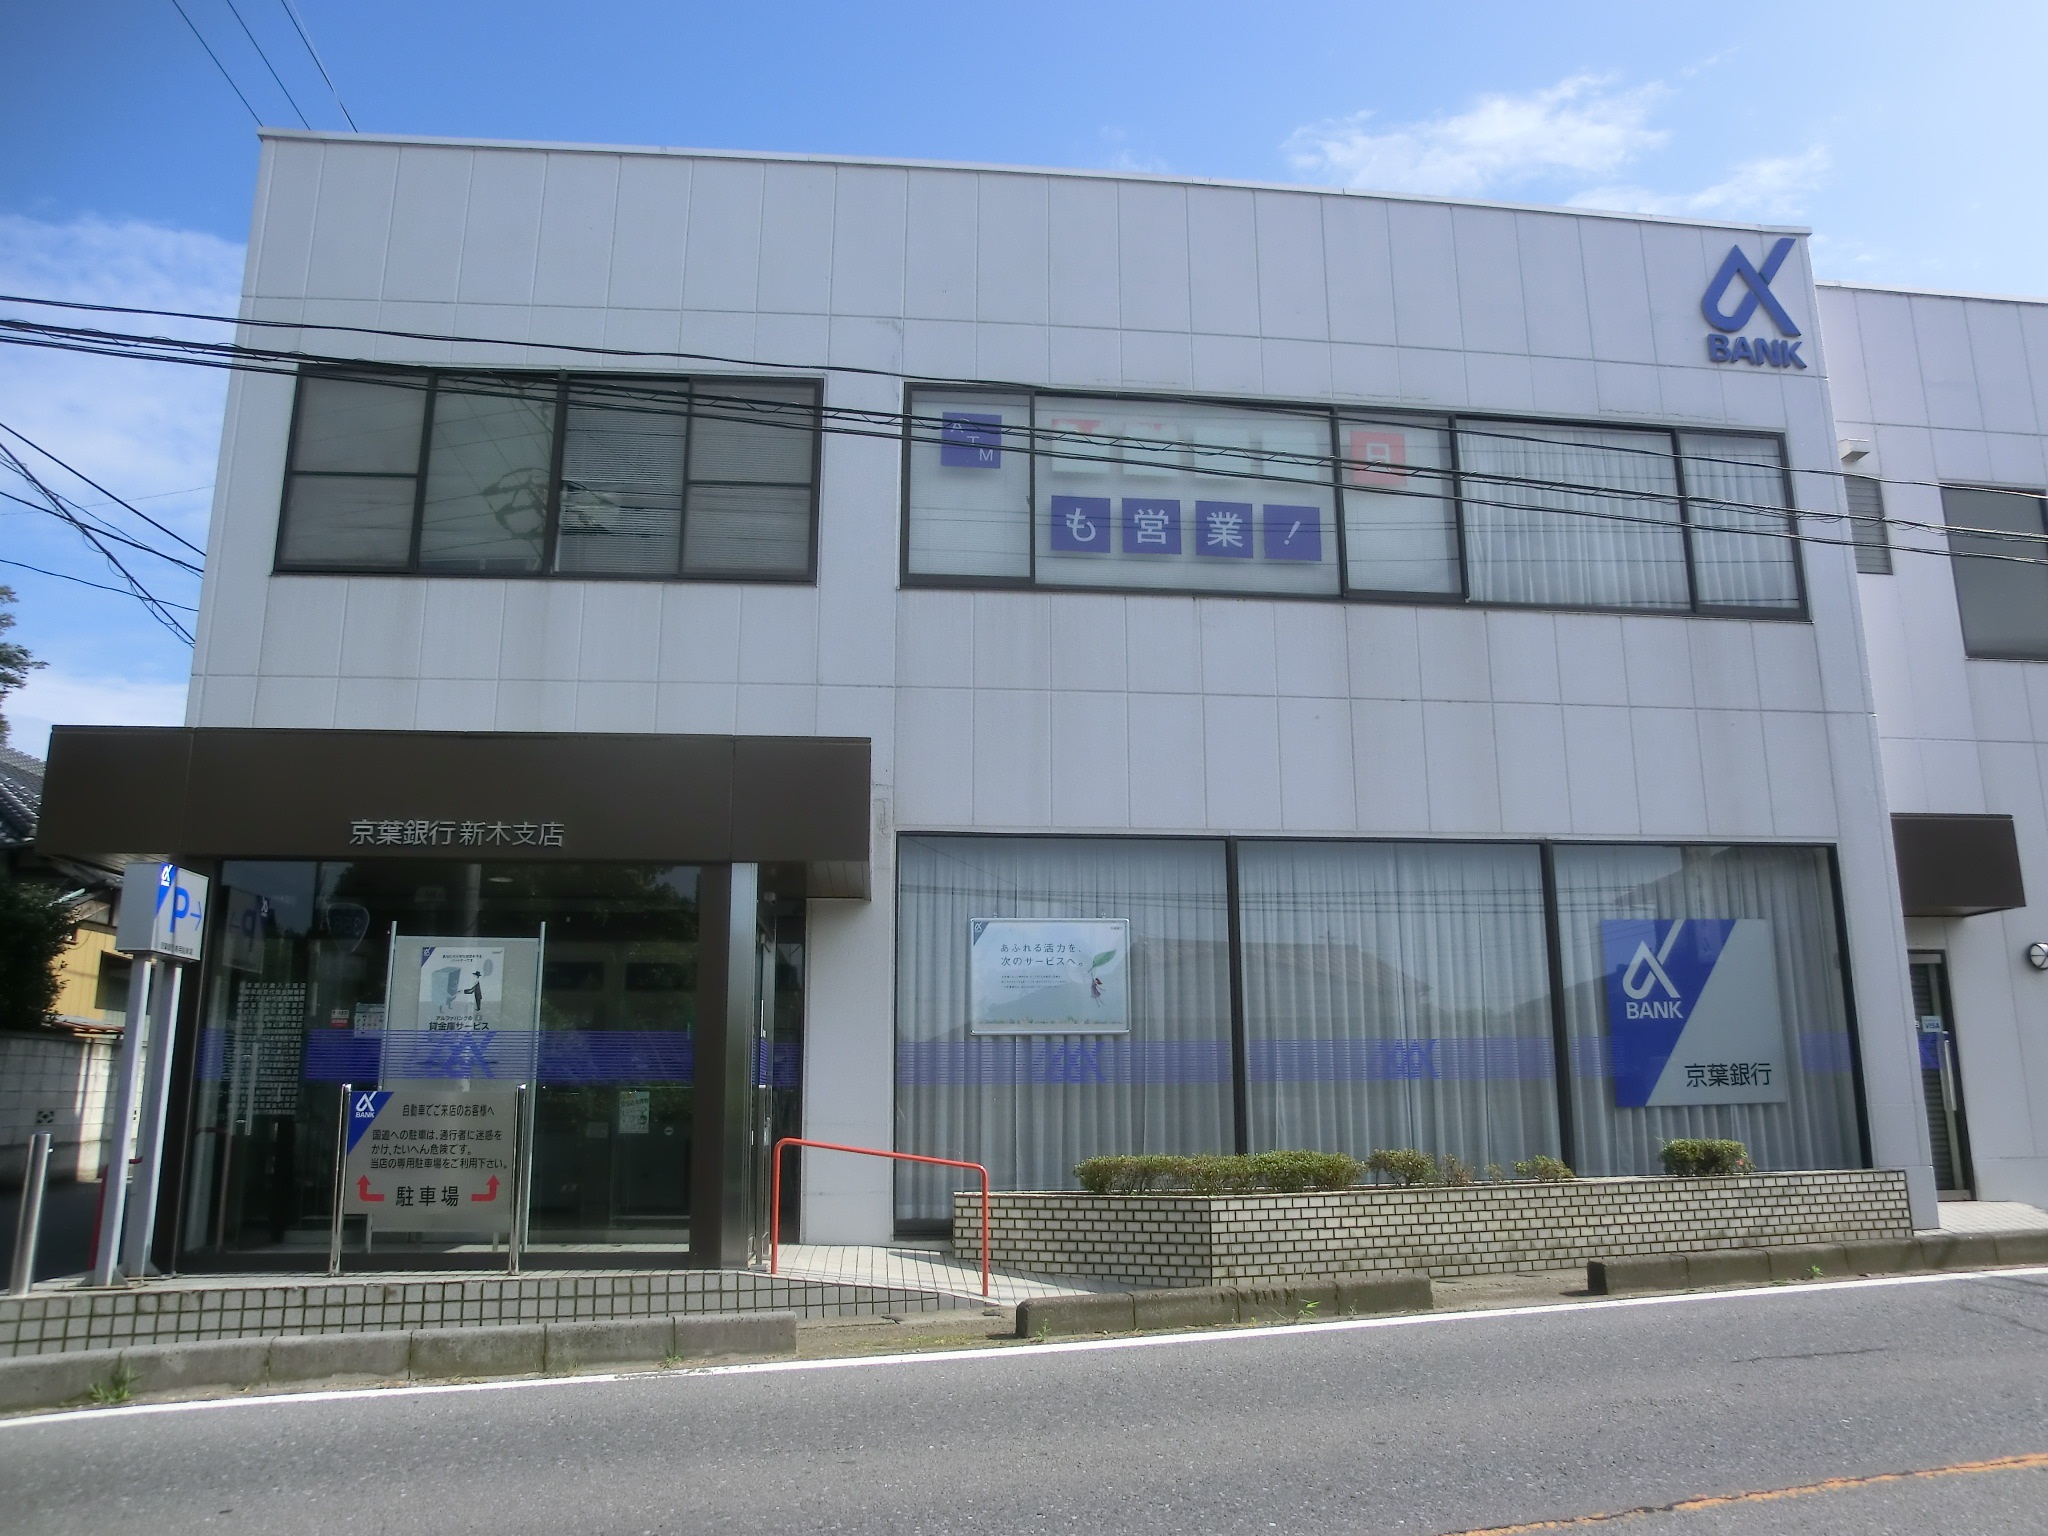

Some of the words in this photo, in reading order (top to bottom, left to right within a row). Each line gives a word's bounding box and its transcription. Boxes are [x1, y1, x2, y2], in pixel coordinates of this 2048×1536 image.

[1707, 333, 1807, 369] BANK
[350, 818, 456, 846] 京葉銀行
[459, 820, 565, 847] 新木支店
[169, 885, 190, 933] P
[1000, 943, 1082, 953] あふれる活力を、
[1000, 956, 1084, 967] 次のサービスへ。
[1626, 1001, 1684, 1020] BANK
[429, 1022, 490, 1031] 貸金庫サービス
[1684, 1062, 1772, 1088] 京葉銀行
[402, 1104, 495, 1117] 自動車でご来店のお客様へ
[372, 1129, 503, 1141] 国道への駐車は、通行者に迷惑を
[371, 1143, 472, 1156] かけ、たいへん危険です。
[370, 1157, 508, 1170] 当店の専用駐車場をご利用下さい。
[395, 1185, 459, 1207] 駐車場
